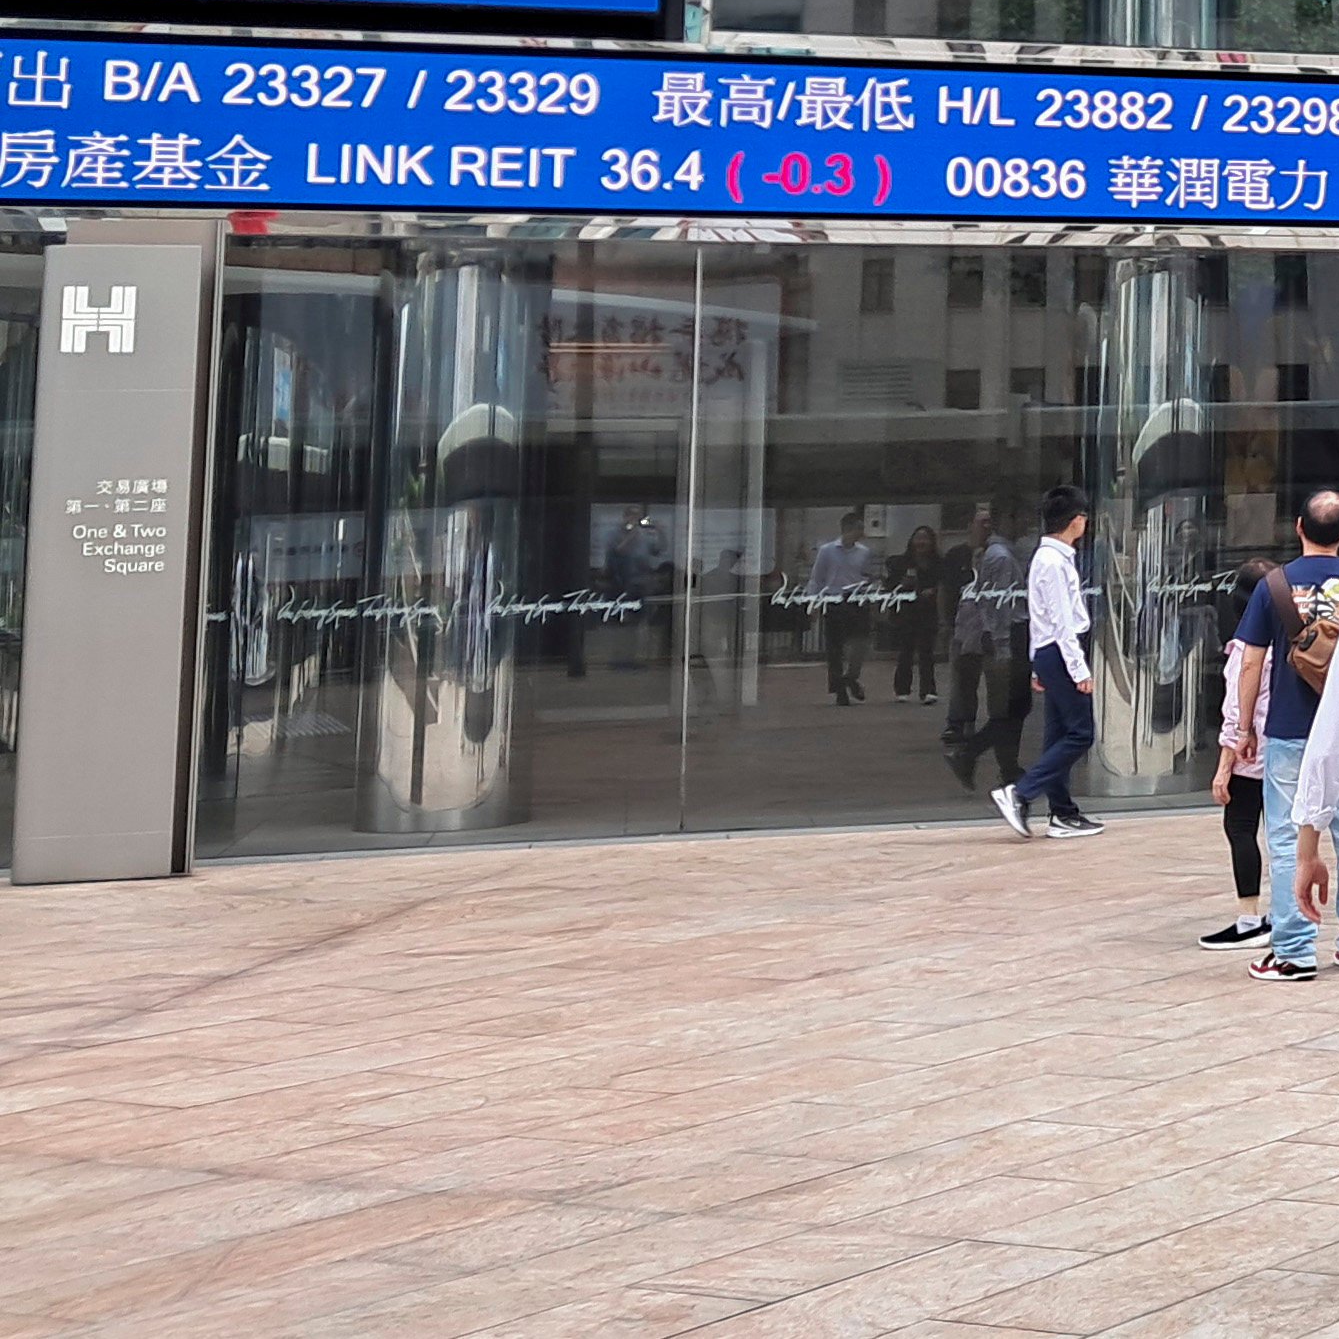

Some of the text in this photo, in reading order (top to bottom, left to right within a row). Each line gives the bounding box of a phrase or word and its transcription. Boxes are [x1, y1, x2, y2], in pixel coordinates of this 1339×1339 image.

[103, 59, 200, 103] B/A
[223, 63, 386, 108] 23327
[445, 69, 600, 116] 23329
[652, 72, 914, 131] 最高/最低
[938, 86, 1015, 126] H/L
[1035, 88, 1172, 130] 23882
[0, 129, 273, 191] 房產基金
[306, 142, 434, 186] LINK
[449, 145, 577, 188] REIT
[600, 148, 705, 191] 36.4
[946, 156, 1087, 199] 00836
[1107, 155, 1328, 211] 華潤電力
[72, 523, 167, 539] One & Two
[82, 541, 165, 558] Exchange
[104, 558, 165, 575] Square
